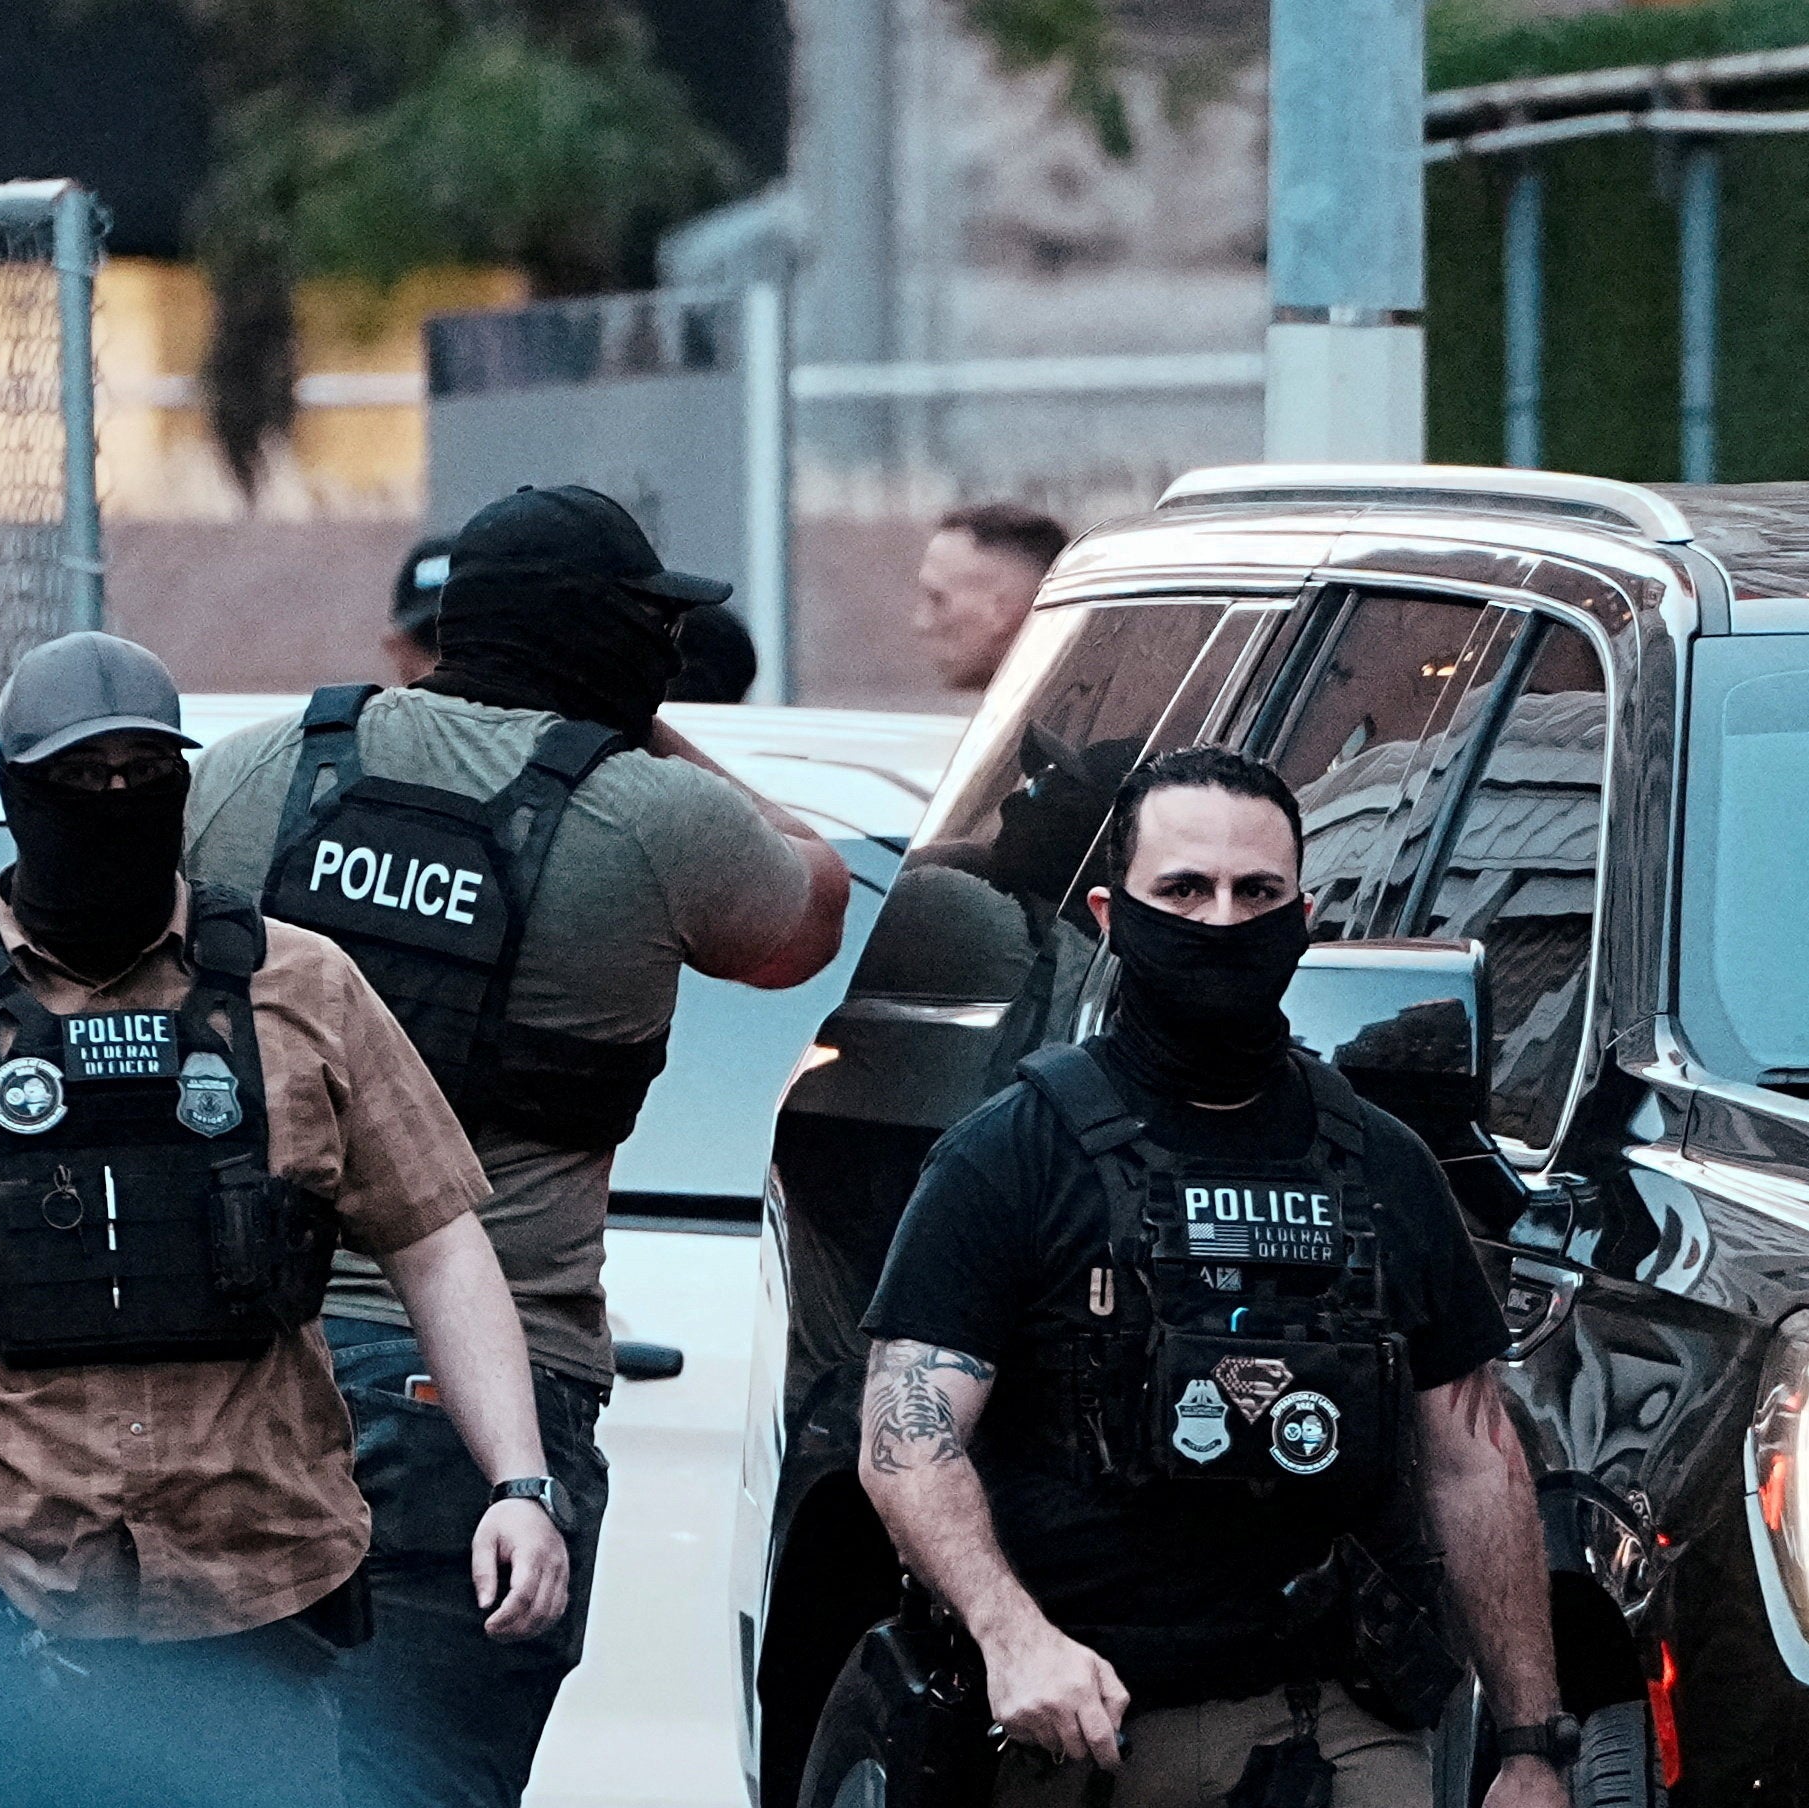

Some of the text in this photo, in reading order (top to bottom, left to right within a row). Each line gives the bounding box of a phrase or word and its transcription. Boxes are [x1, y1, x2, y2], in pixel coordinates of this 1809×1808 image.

[310, 840, 483, 925] POLICE
[69, 1015, 170, 1044] POLICE
[81, 1045, 158, 1060] FEDERAL
[85, 1060, 159, 1075] OFFICER
[1185, 1187, 1333, 1227] POLICE
[1255, 1226, 1333, 1245] FEDERAL
[1258, 1242, 1332, 1261] OFFICER
